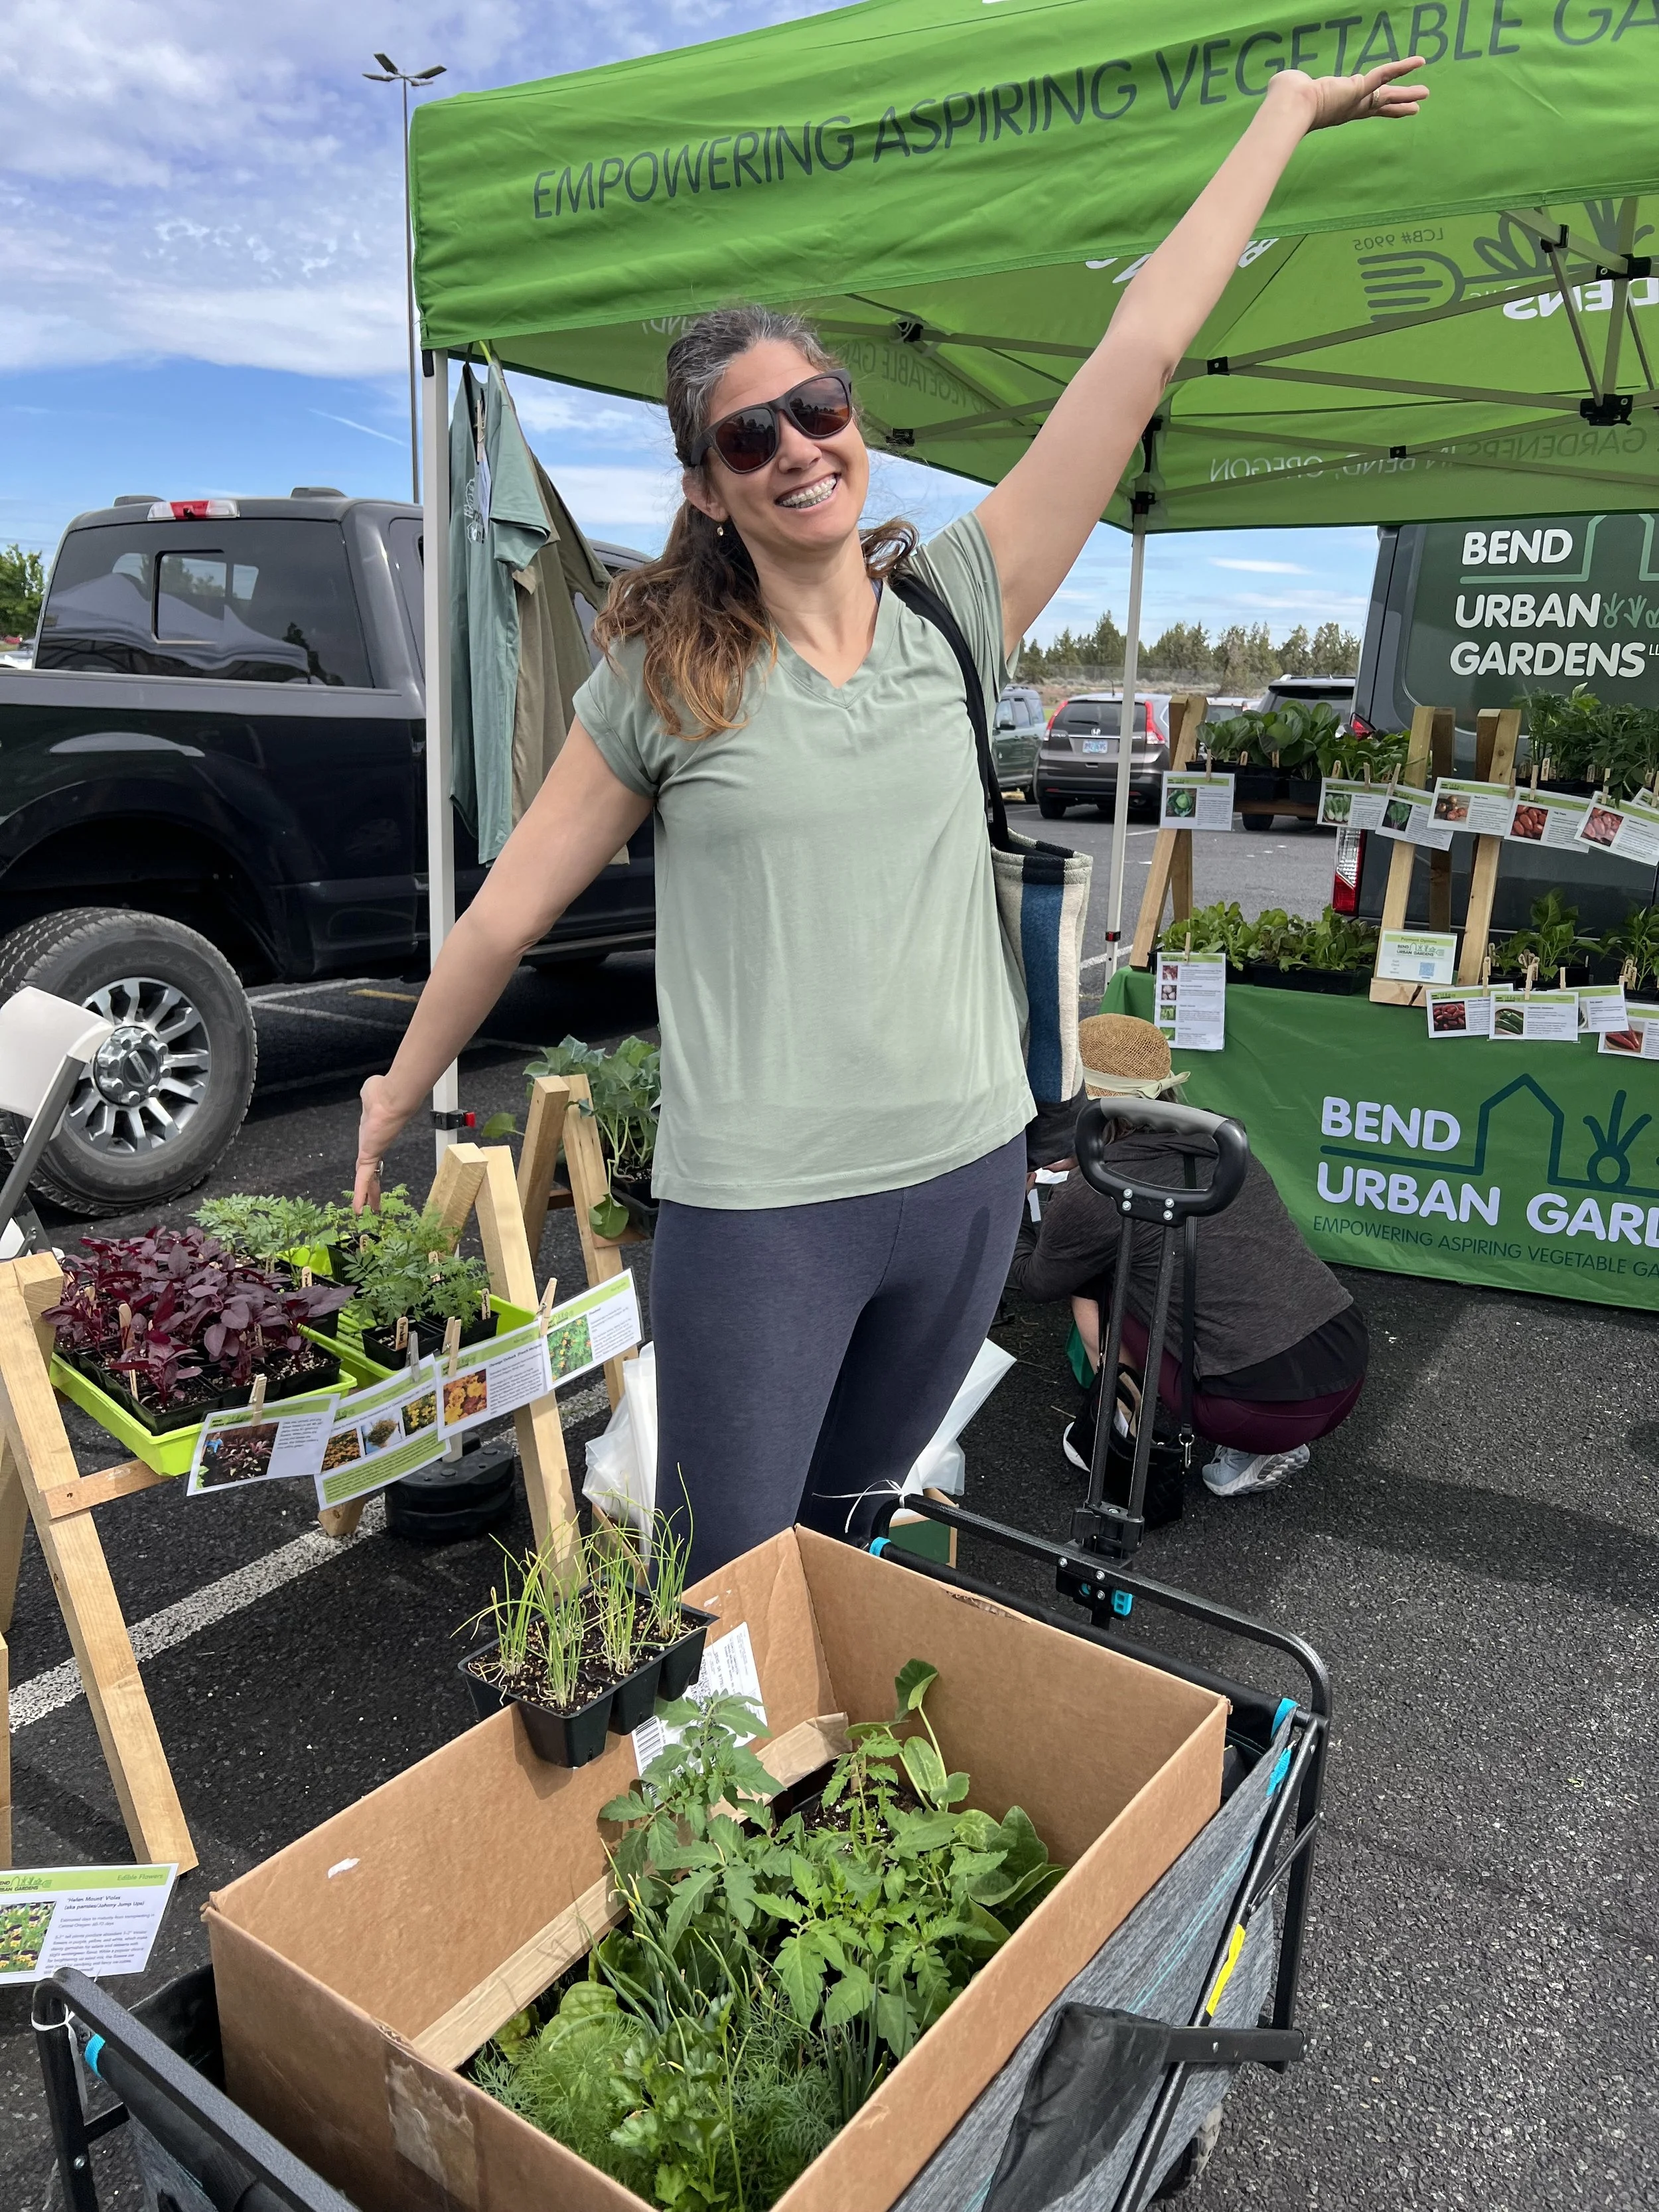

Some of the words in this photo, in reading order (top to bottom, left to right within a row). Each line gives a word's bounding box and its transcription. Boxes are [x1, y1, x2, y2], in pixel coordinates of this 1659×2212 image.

[534, 115, 855, 219] EMPOWERING
[873, 58, 1137, 163] ASPIRING
[1462, 528, 1573, 565] BEND
[1455, 593, 1601, 628] URBAN
[1450, 641, 1646, 678] GARDENS
[1321, 1096, 1461, 1151] BEND
[1317, 1161, 1500, 1226] URBAN
[1313, 1216, 1433, 1246] EMPOWERING
[1437, 1235, 1522, 1260] ASPIRING
[1528, 1245, 1626, 1274] VEGETABLE
